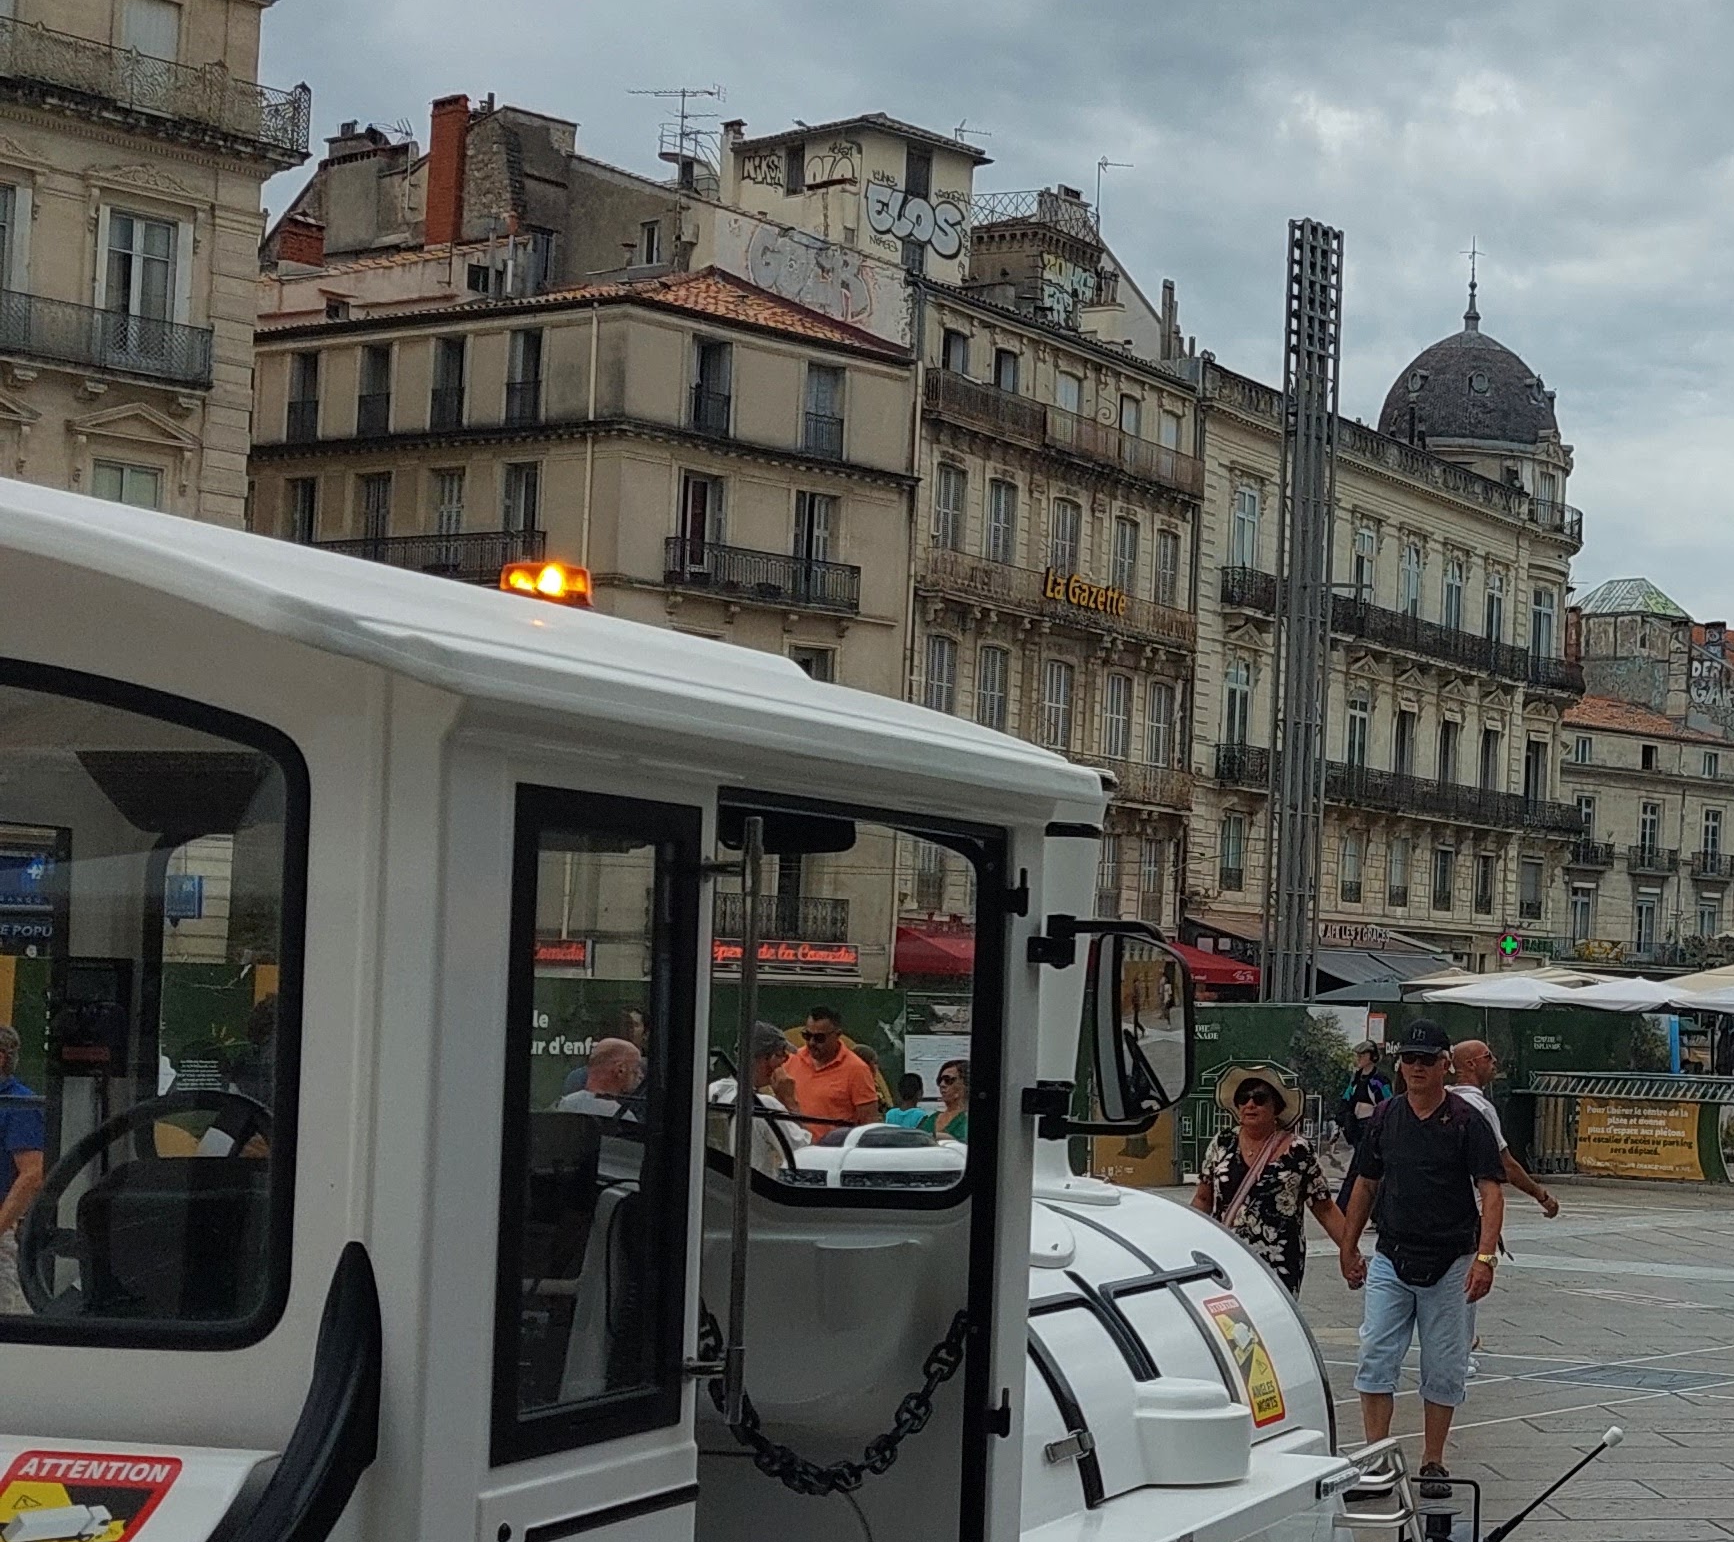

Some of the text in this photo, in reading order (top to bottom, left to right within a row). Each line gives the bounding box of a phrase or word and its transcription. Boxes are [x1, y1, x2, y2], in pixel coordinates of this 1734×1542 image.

[1043, 566, 1127, 616] La Gazette
[18, 1457, 172, 1483] ATTENTION
